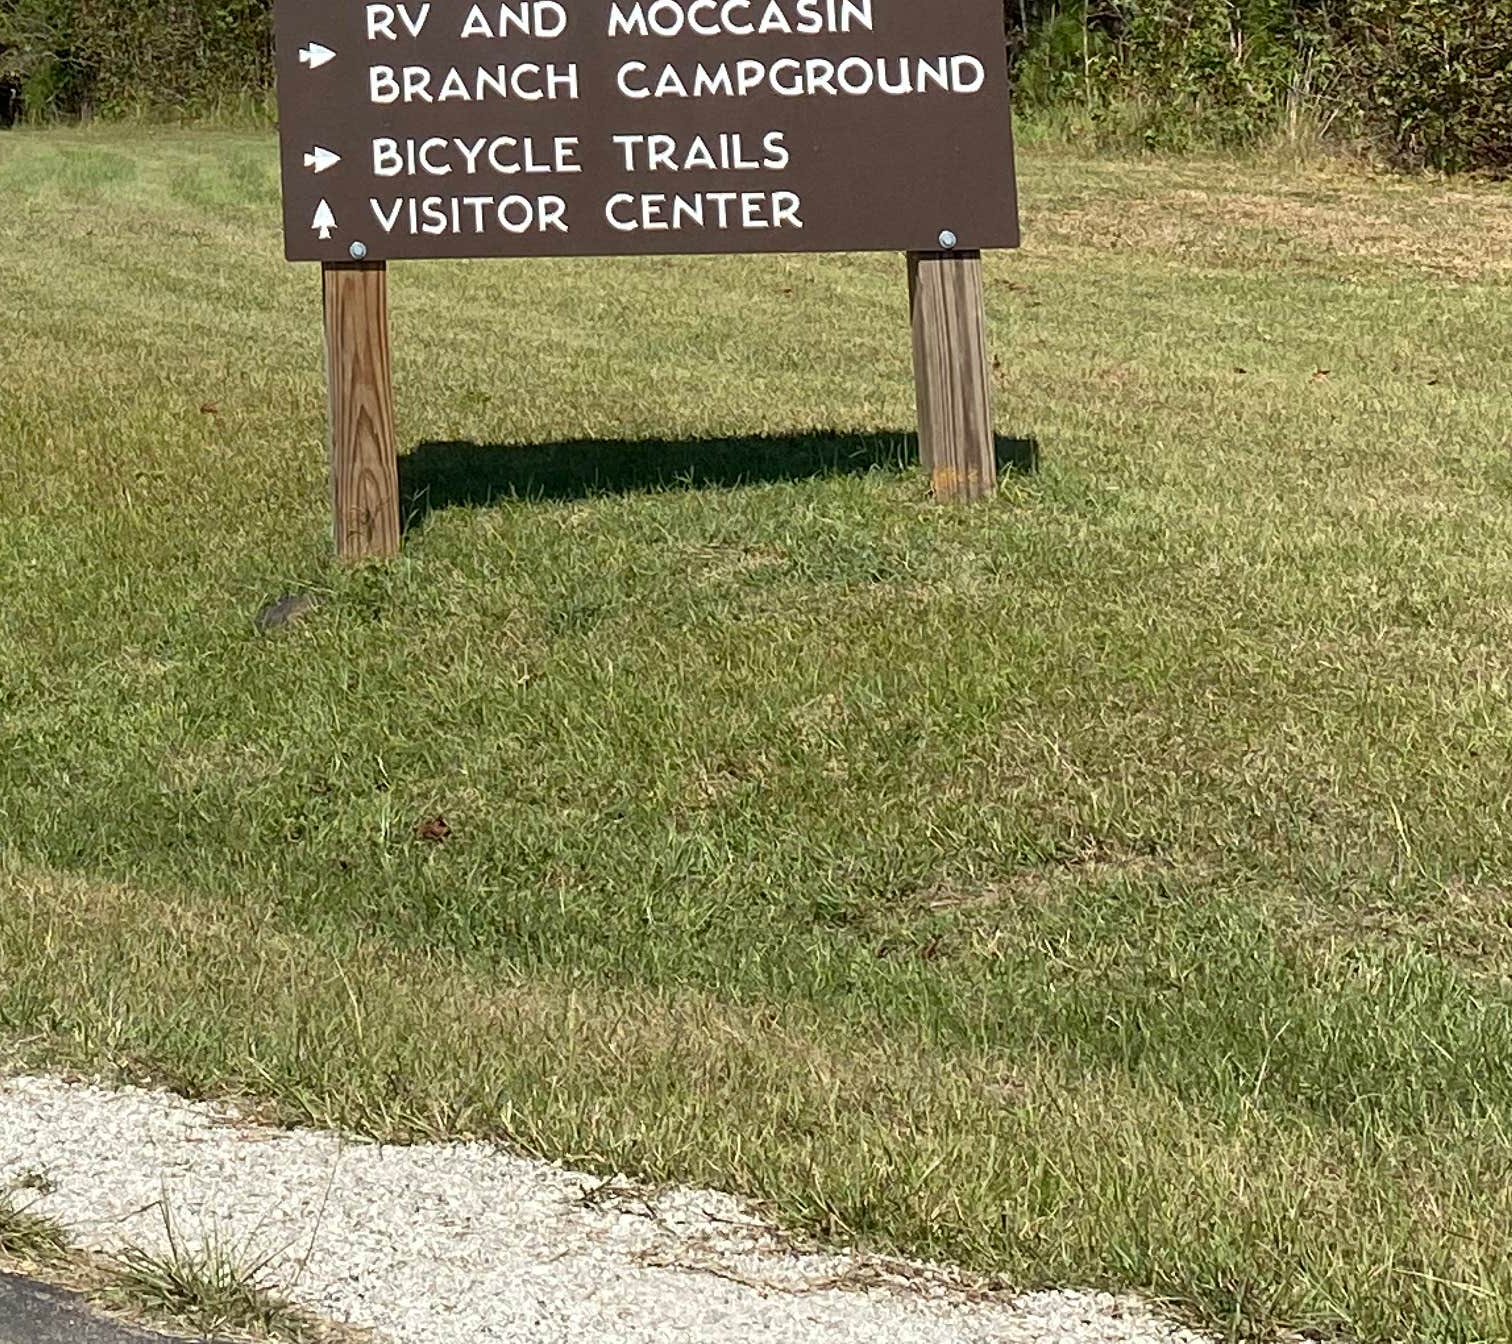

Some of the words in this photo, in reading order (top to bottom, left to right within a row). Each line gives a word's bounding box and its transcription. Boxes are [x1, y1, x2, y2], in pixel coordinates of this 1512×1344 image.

[366, 3, 430, 40] RV
[461, 1, 566, 38] AND
[370, 64, 578, 103] BRANCH
[617, 55, 984, 98] CAMPGROUND
[373, 136, 581, 176] BICYCLE
[613, 132, 788, 171] TRAILS
[370, 195, 568, 234] VISITOR
[606, 192, 802, 231] CENTER
